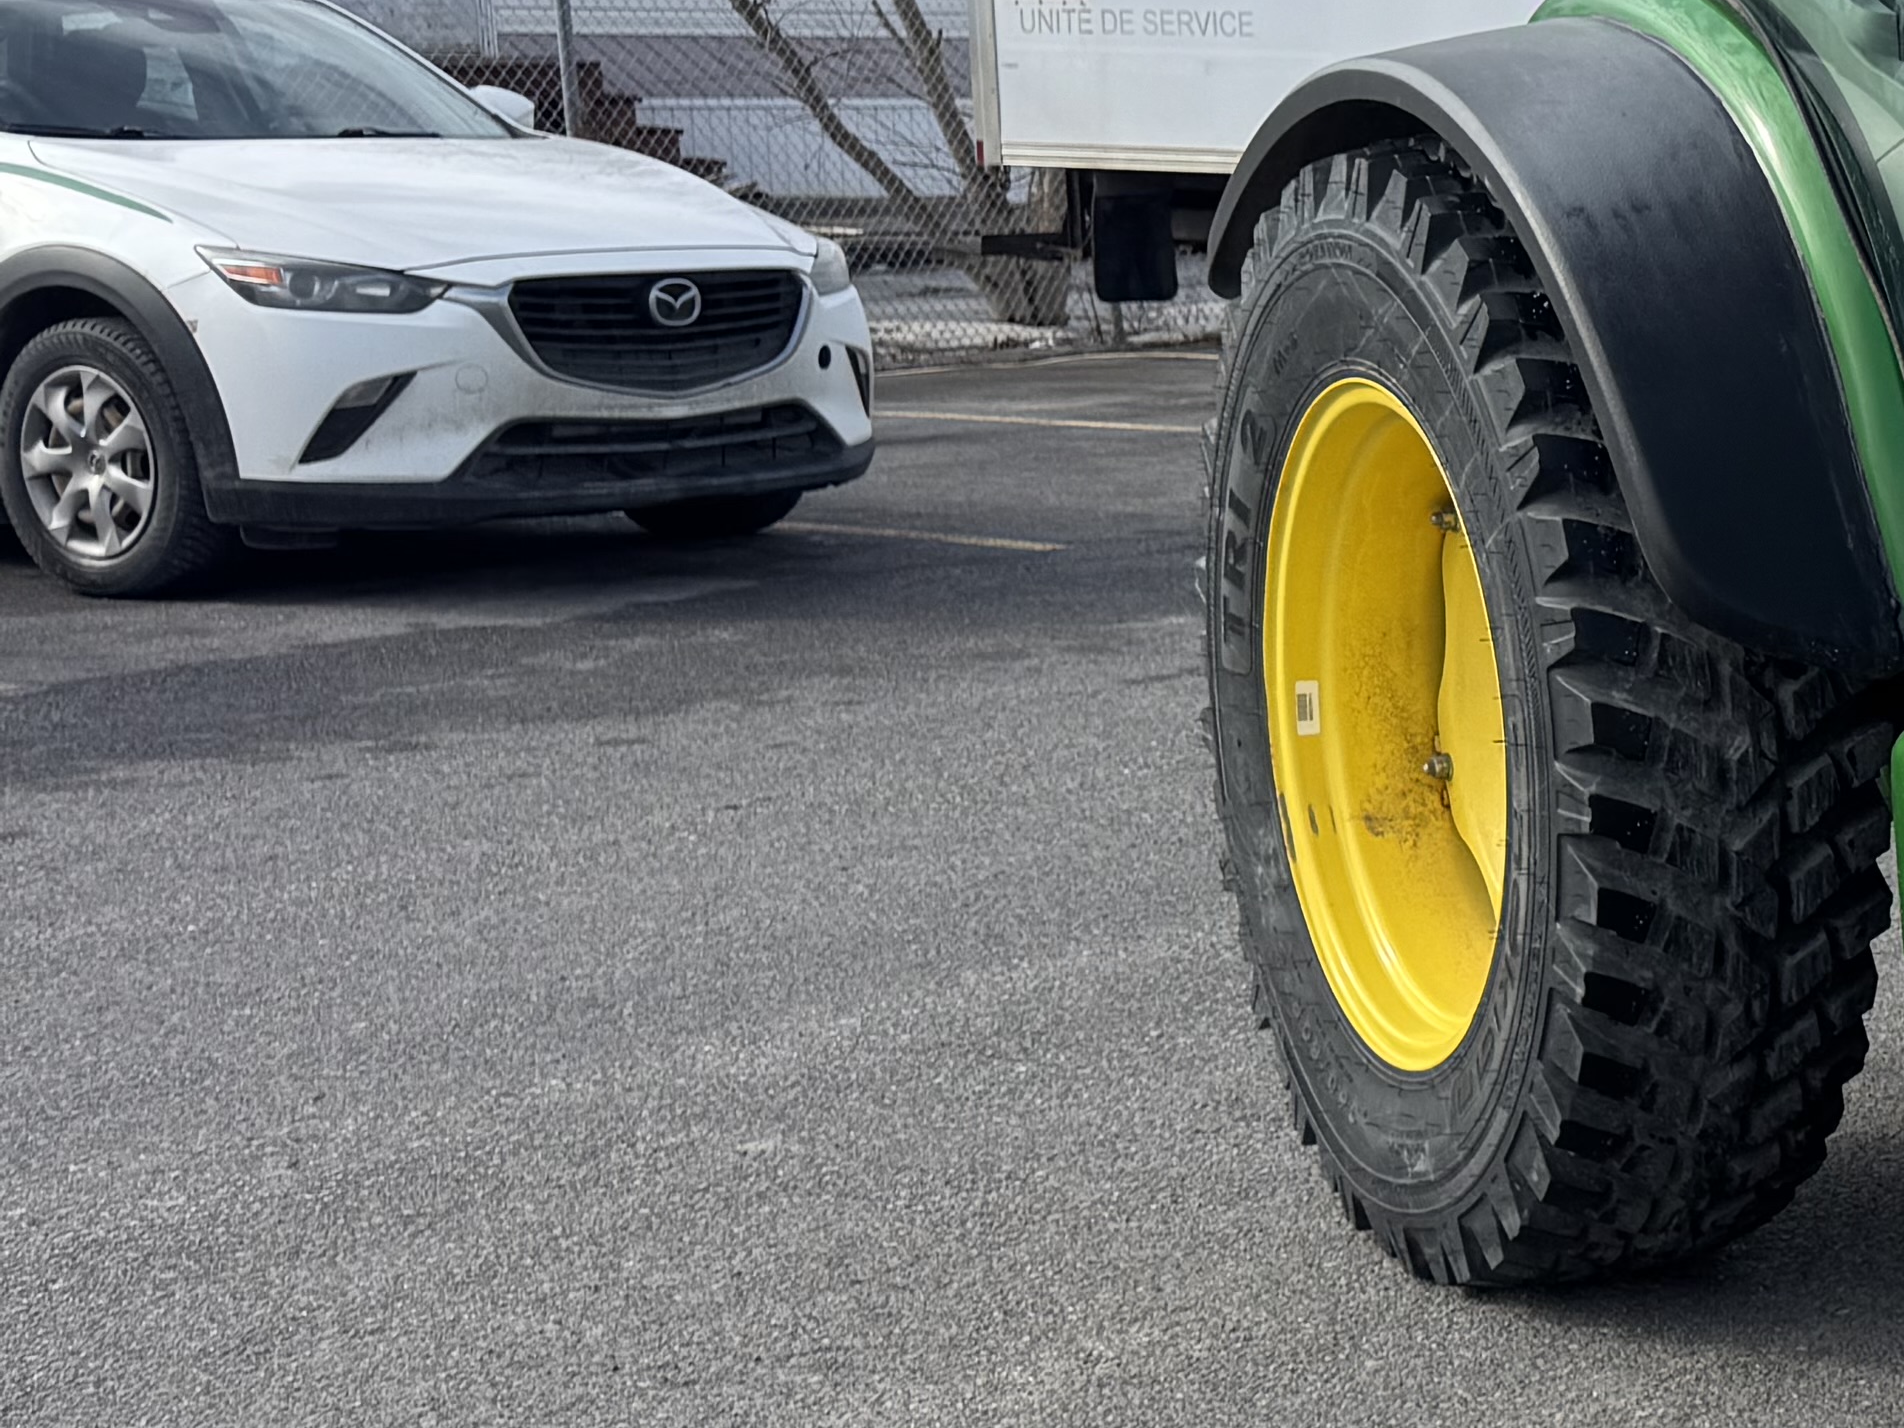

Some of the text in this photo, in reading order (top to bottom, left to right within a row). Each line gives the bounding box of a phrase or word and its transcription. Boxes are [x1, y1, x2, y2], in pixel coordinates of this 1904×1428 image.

[1100, 9, 1134, 35] DE
[1142, 9, 1254, 37] SERVICE
[1222, 408, 1276, 644] TRI 2
